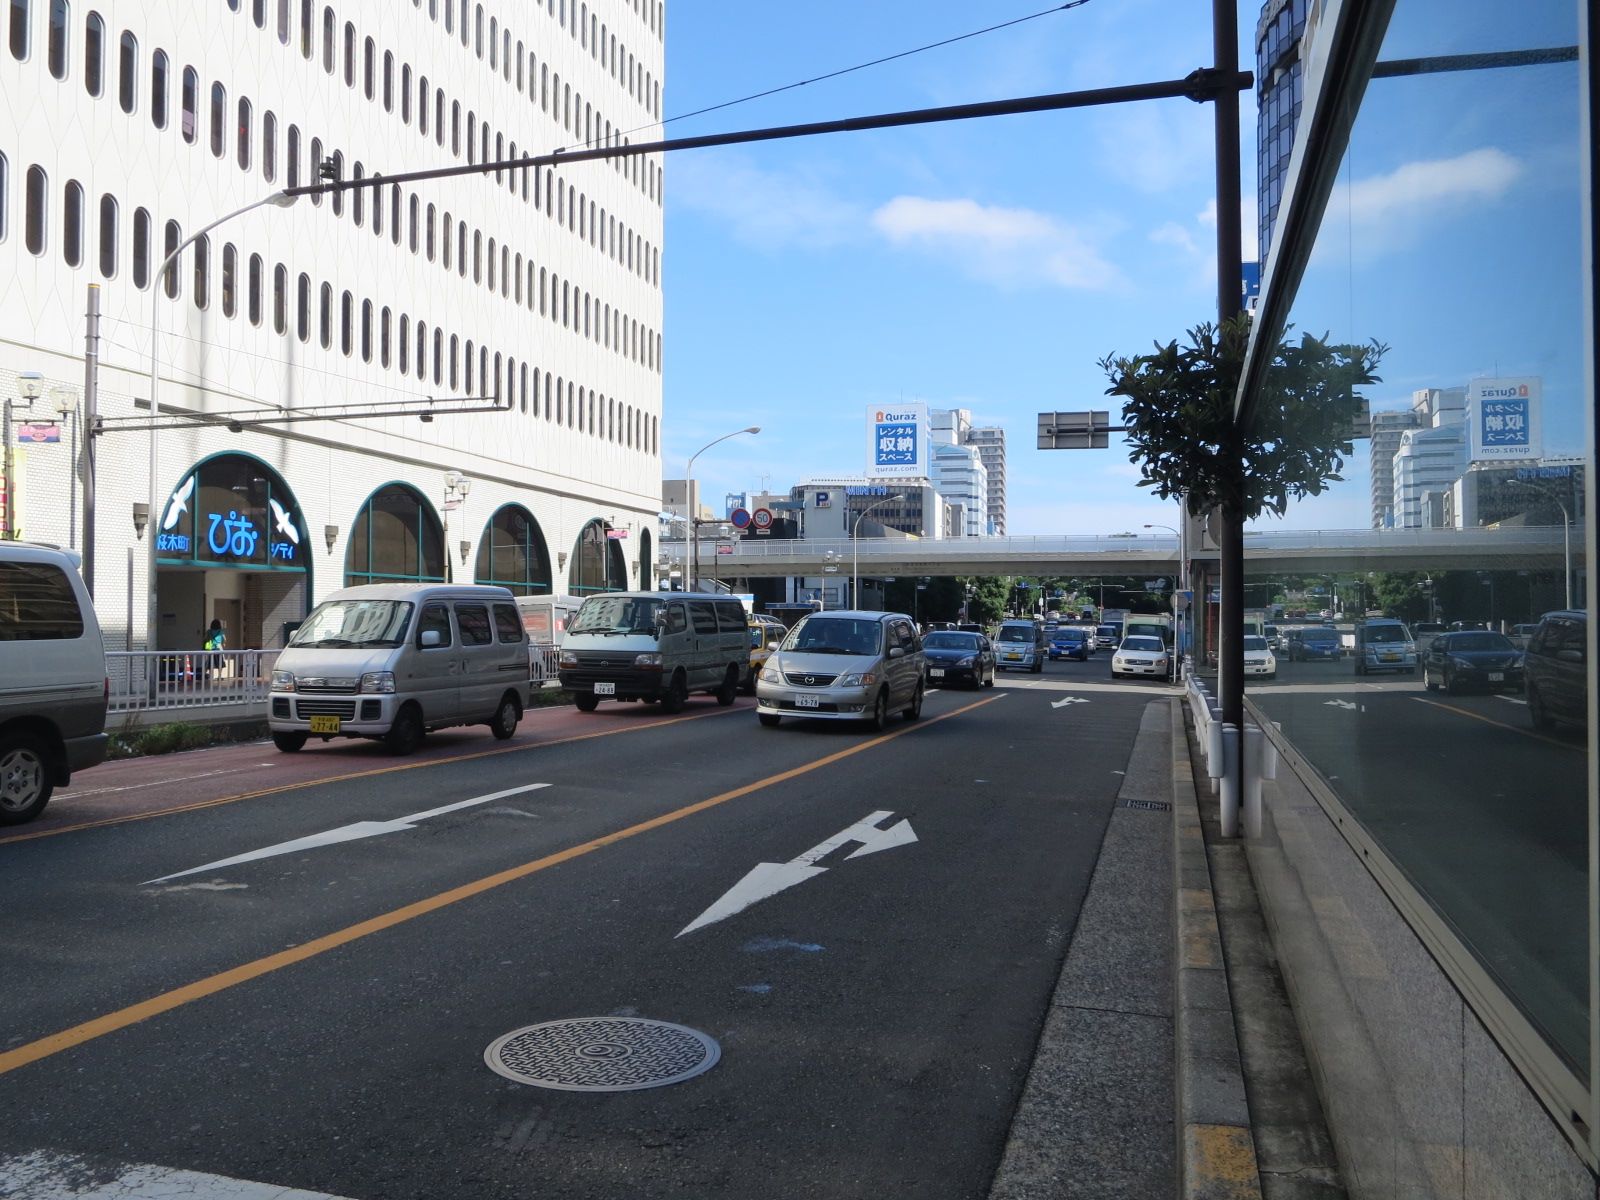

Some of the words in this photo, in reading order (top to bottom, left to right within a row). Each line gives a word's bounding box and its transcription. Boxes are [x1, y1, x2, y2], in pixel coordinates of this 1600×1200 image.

[885, 413, 917, 421] Quraz
[879, 427, 913, 435] レンタル
[879, 437, 914, 451] 収納
[879, 453, 913, 461] スペース
[816, 492, 829, 507] P
[757, 513, 769, 523] 50
[208, 510, 258, 557] ぴお
